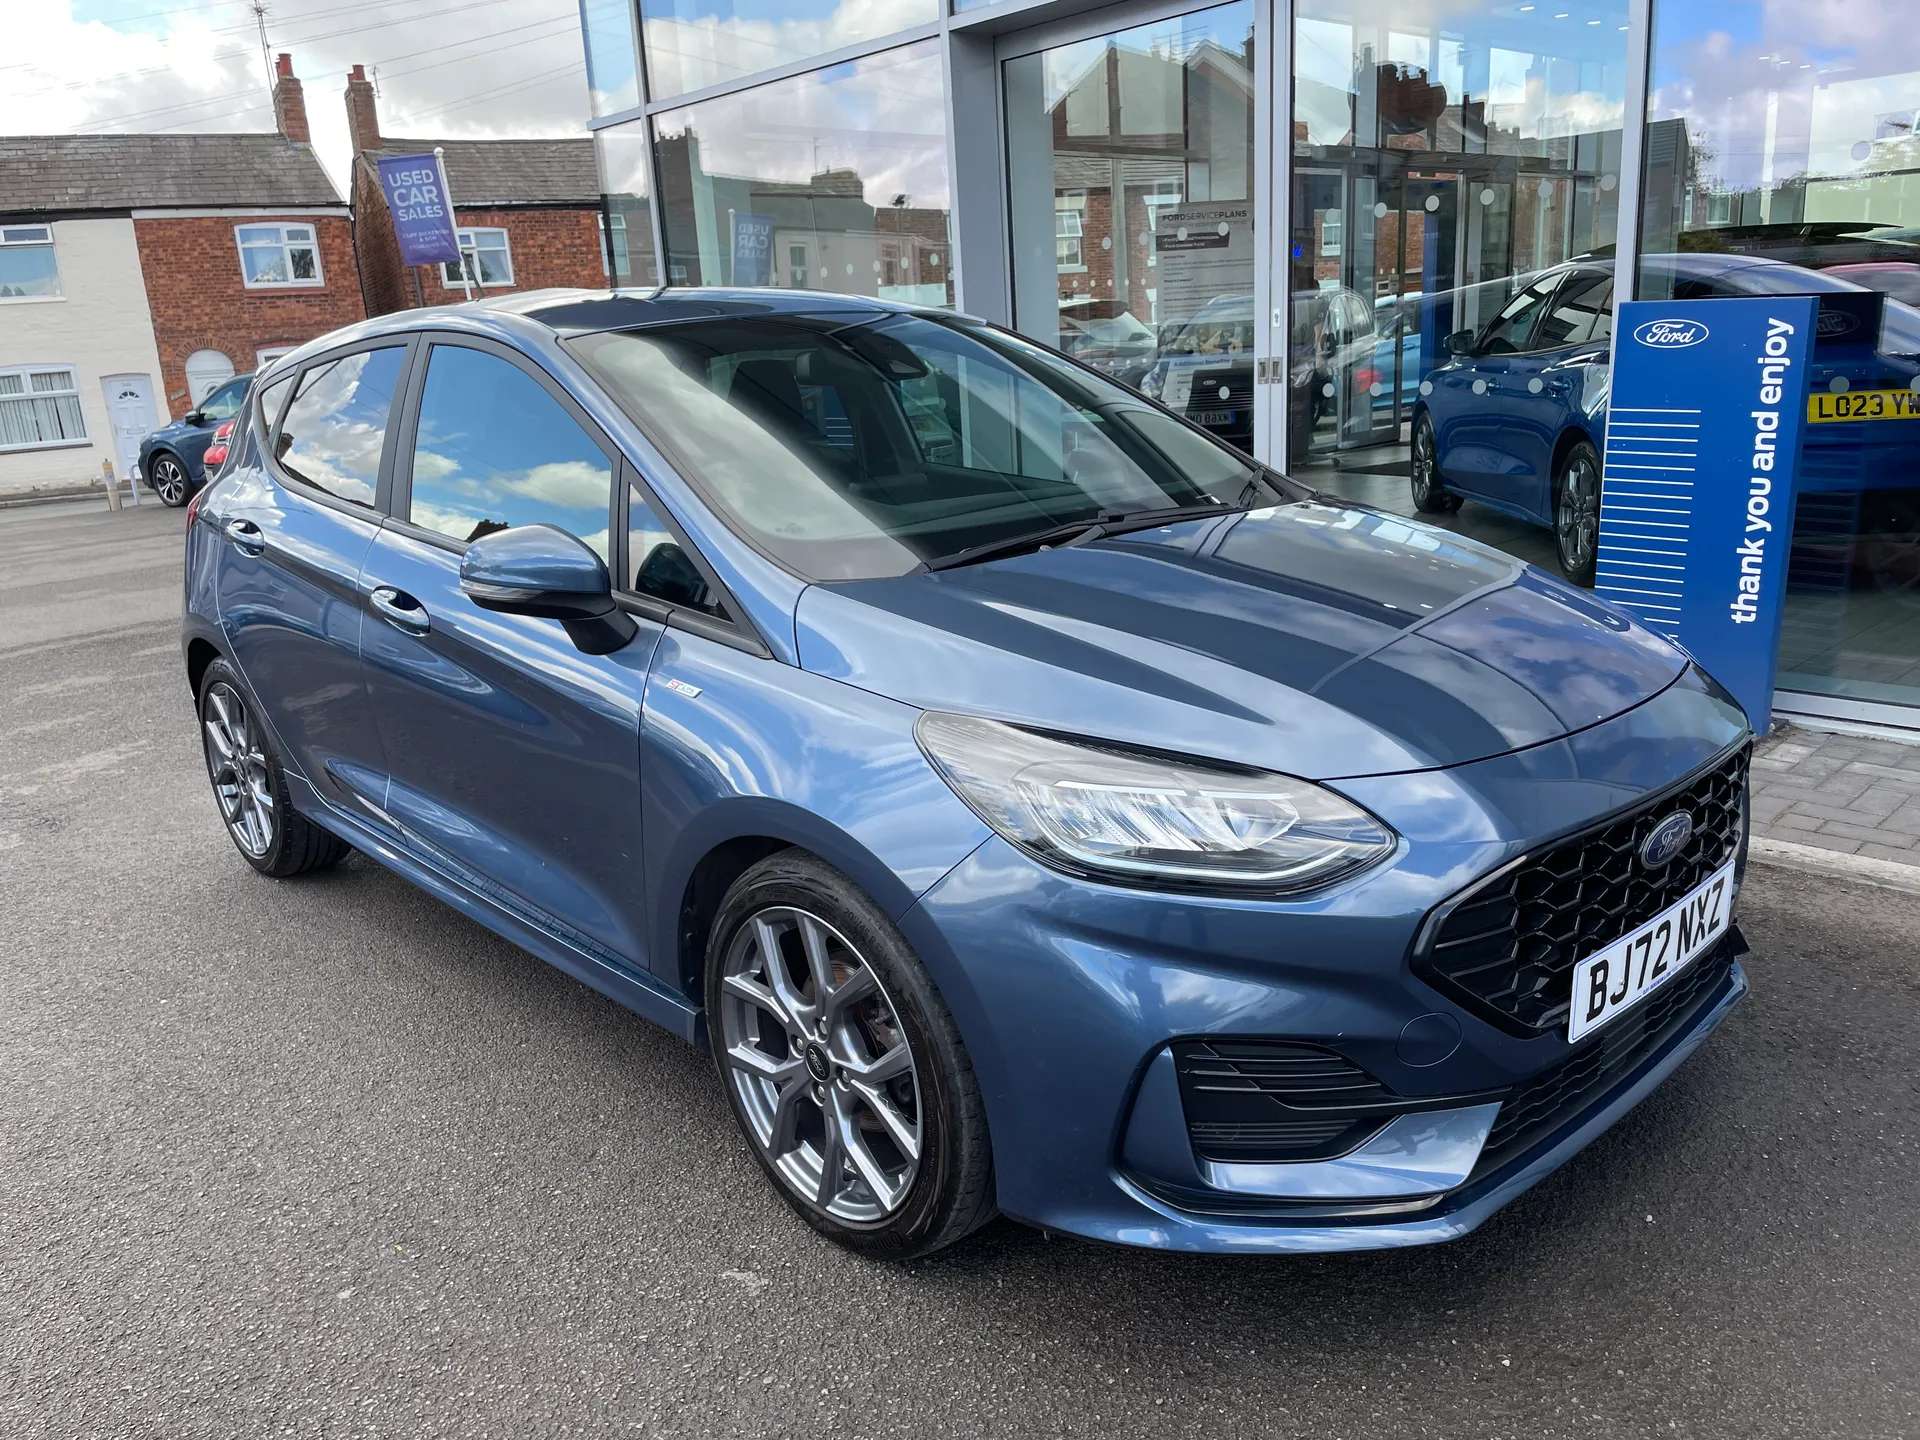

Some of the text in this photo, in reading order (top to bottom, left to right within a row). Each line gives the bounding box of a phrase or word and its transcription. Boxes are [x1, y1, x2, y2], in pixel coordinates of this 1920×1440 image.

[388, 169, 434, 187] USED
[393, 185, 439, 207] CAR
[398, 205, 444, 222] SALES
[1646, 323, 1696, 343] Ford
[1818, 394, 1884, 418] LO23
[1730, 317, 1794, 624] thank you and enjoy
[1657, 825, 1688, 859] Ford
[1585, 878, 1725, 1023] BJ72 NXZ
